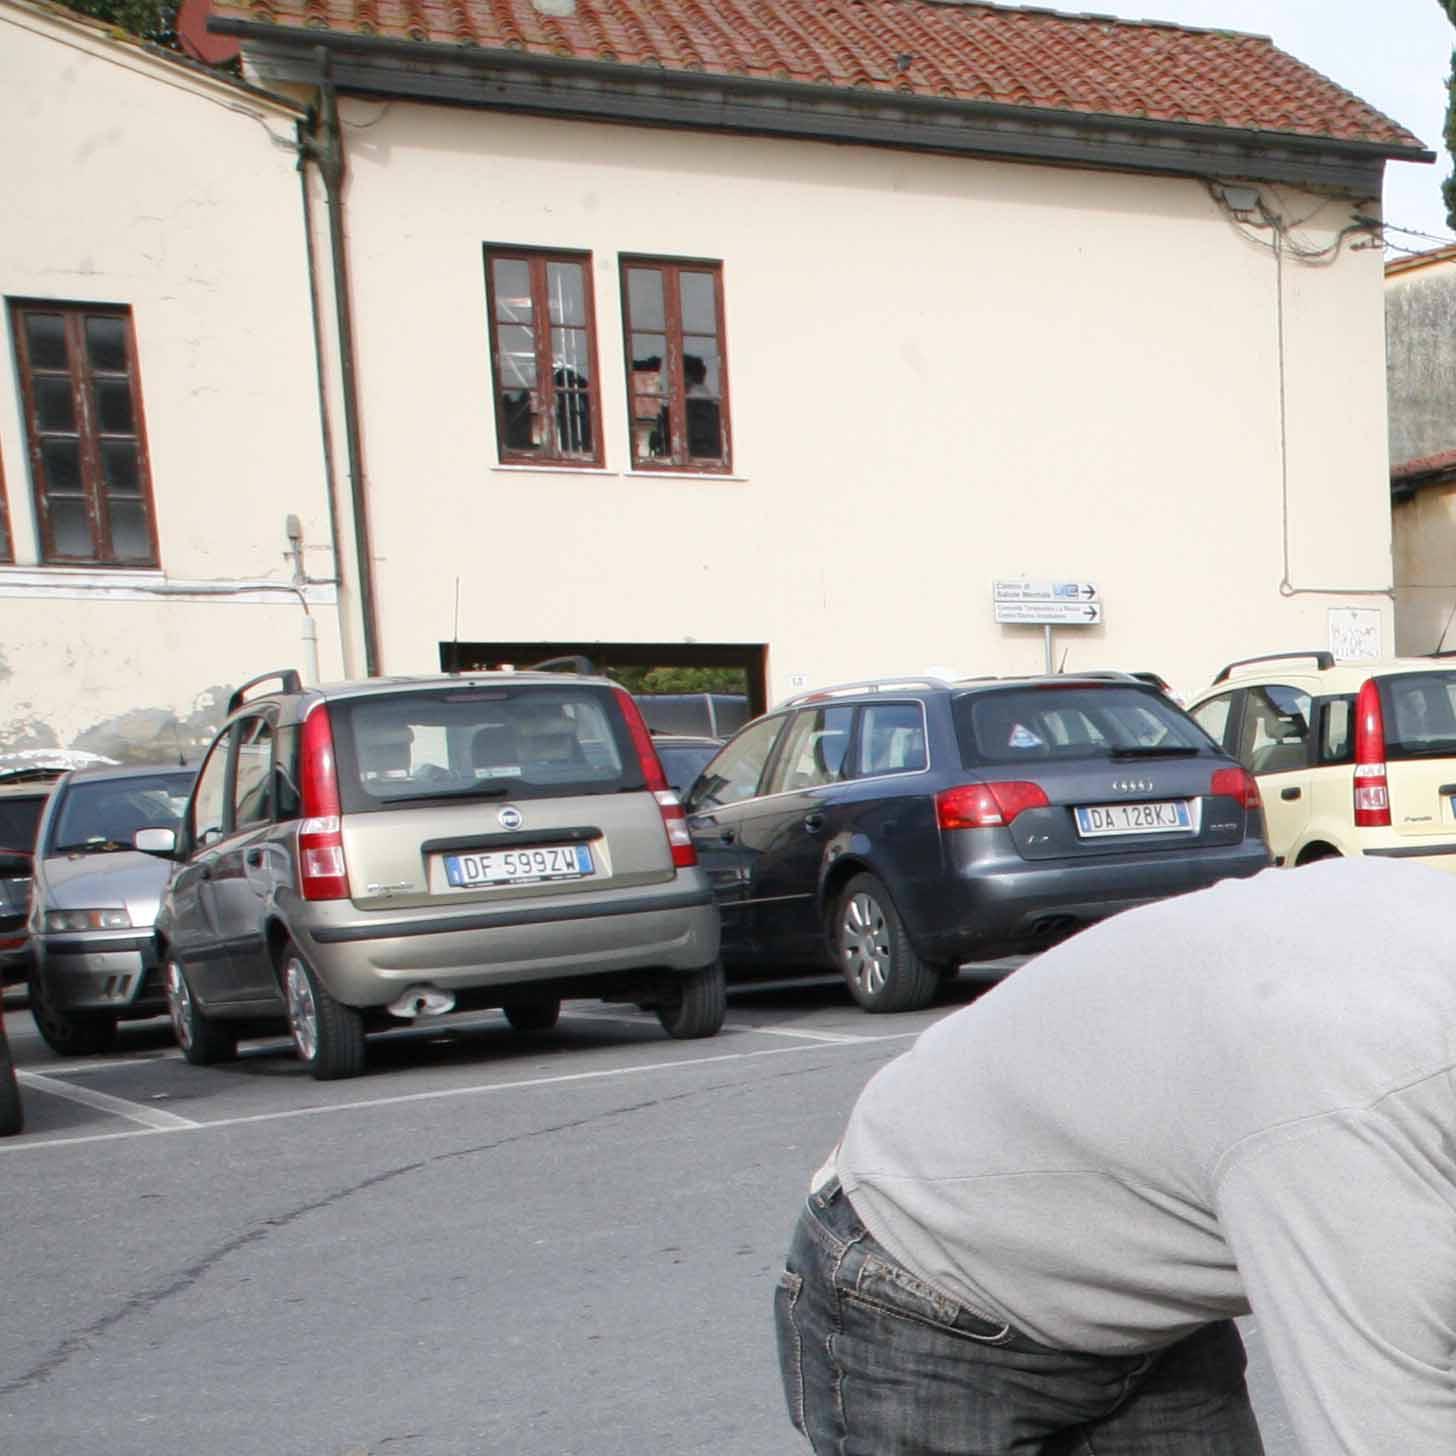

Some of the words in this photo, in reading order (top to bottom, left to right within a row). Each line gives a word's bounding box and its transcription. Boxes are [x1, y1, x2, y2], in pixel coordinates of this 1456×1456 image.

[1090, 809, 1115, 829] DA
[1123, 802, 1178, 827] 128KJ
[463, 855, 492, 880] DF
[503, 849, 577, 875] 599ZW
